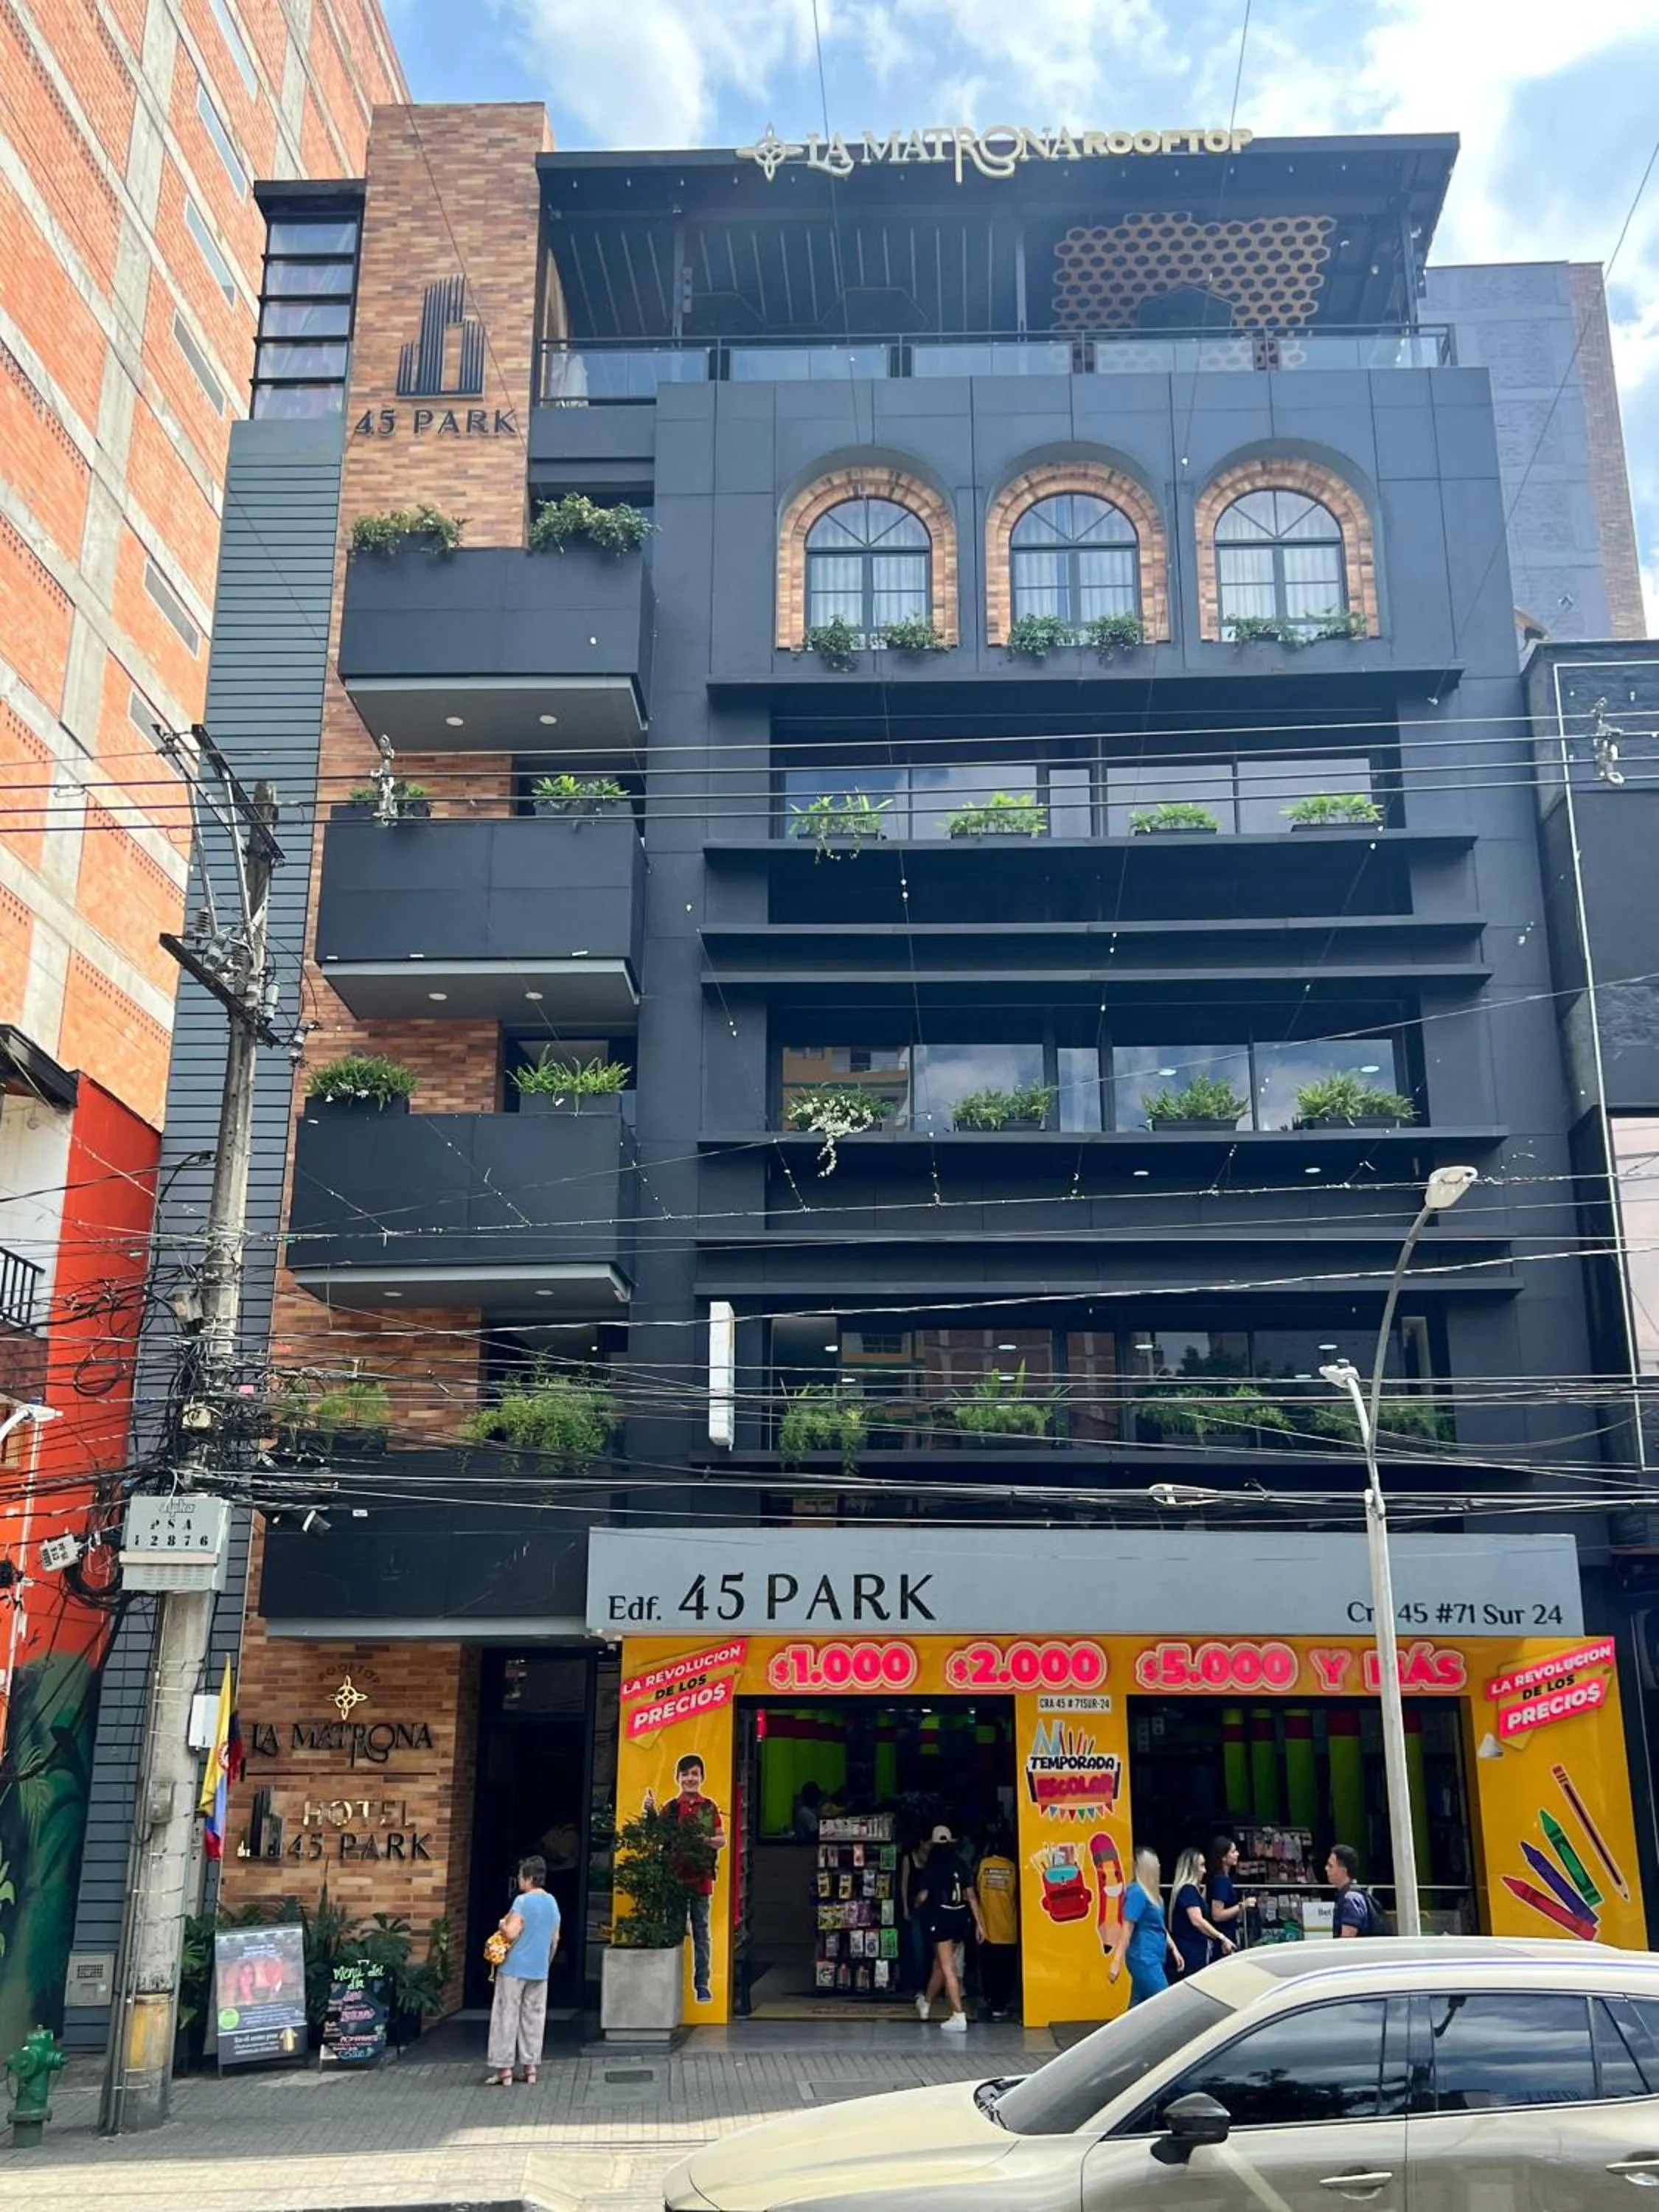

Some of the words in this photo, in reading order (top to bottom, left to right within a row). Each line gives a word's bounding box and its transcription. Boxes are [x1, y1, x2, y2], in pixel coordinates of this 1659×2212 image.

[807, 131, 855, 178] LA
[861, 124, 1081, 186] MATRONA
[1083, 128, 1254, 156] ROOFTOP
[354, 408, 396, 437] 45
[413, 408, 517, 437] PARK
[608, 1594, 662, 1621] Edf.
[678, 1572, 745, 1621] 45
[765, 1572, 937, 1621] PARK
[1347, 1601, 1379, 1624] Cr
[1397, 1602, 1429, 1624] 45
[1436, 1603, 1475, 1624] #71
[1483, 1603, 1526, 1625] Sur
[1532, 1604, 1563, 1625] 24
[622, 1680, 642, 1695] LA
[645, 1645, 741, 1687] REVOLUCION
[771, 1644, 915, 1688] $1.000
[947, 1643, 1105, 1688] $2.000
[1138, 1644, 1297, 1689] $5.000
[1312, 1649, 1352, 1691] Y
[1491, 1680, 1512, 1695] LA
[1514, 1645, 1611, 1687] REVOLUCION
[655, 1685, 675, 1700] DE
[678, 1674, 707, 1692] LOS
[1523, 1685, 1543, 1700] DE
[1547, 1674, 1576, 1692] LOS
[251, 1722, 280, 1757] LA
[291, 1722, 434, 1769] MATRONA
[1029, 1756, 1116, 1770] TEMPORADA
[1036, 1773, 1114, 1798] ESCOLAR
[303, 1800, 417, 1829] HOTEL
[287, 1832, 323, 1860] 45
[340, 1832, 433, 1861] PARK
